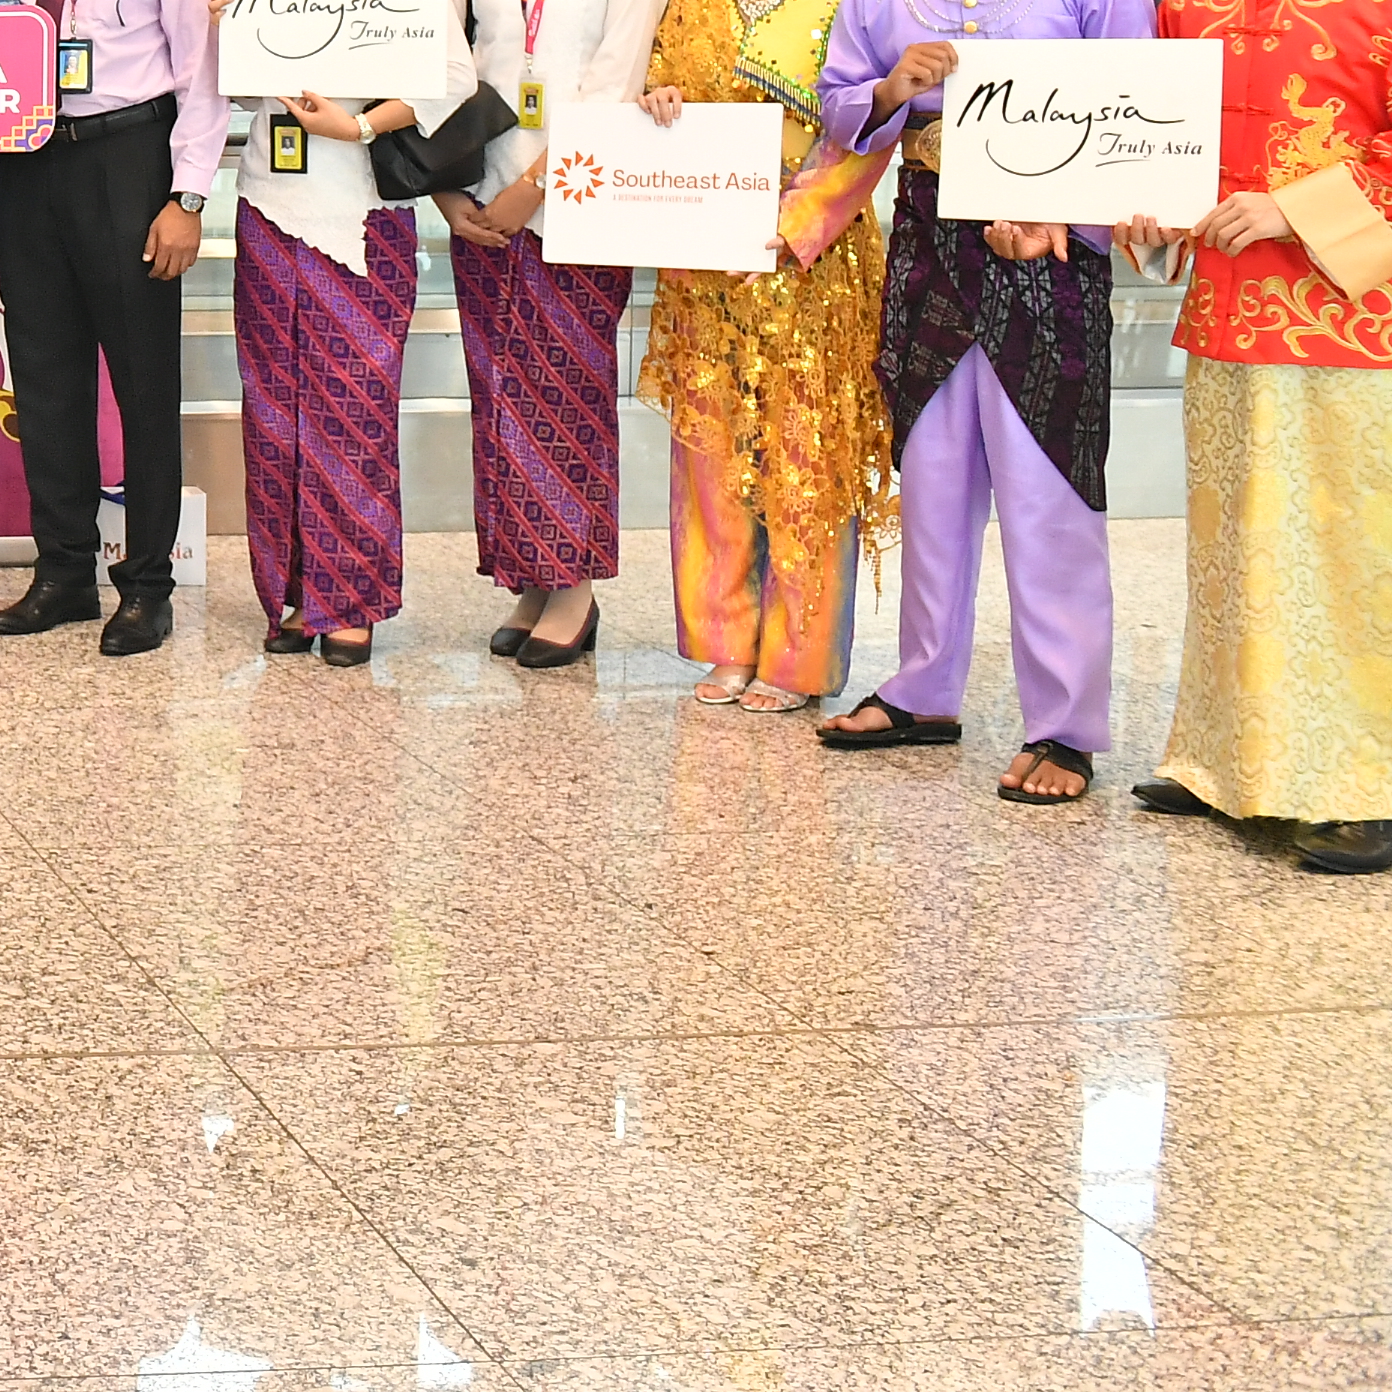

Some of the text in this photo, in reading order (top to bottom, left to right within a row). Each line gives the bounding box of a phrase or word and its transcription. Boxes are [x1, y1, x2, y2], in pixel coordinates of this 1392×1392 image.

[349, 20, 435, 42] Truly Asia
[957, 79, 1186, 176] Malaysia
[1097, 132, 1203, 158] Truly Asia
[612, 169, 771, 191] Southeast Asia
